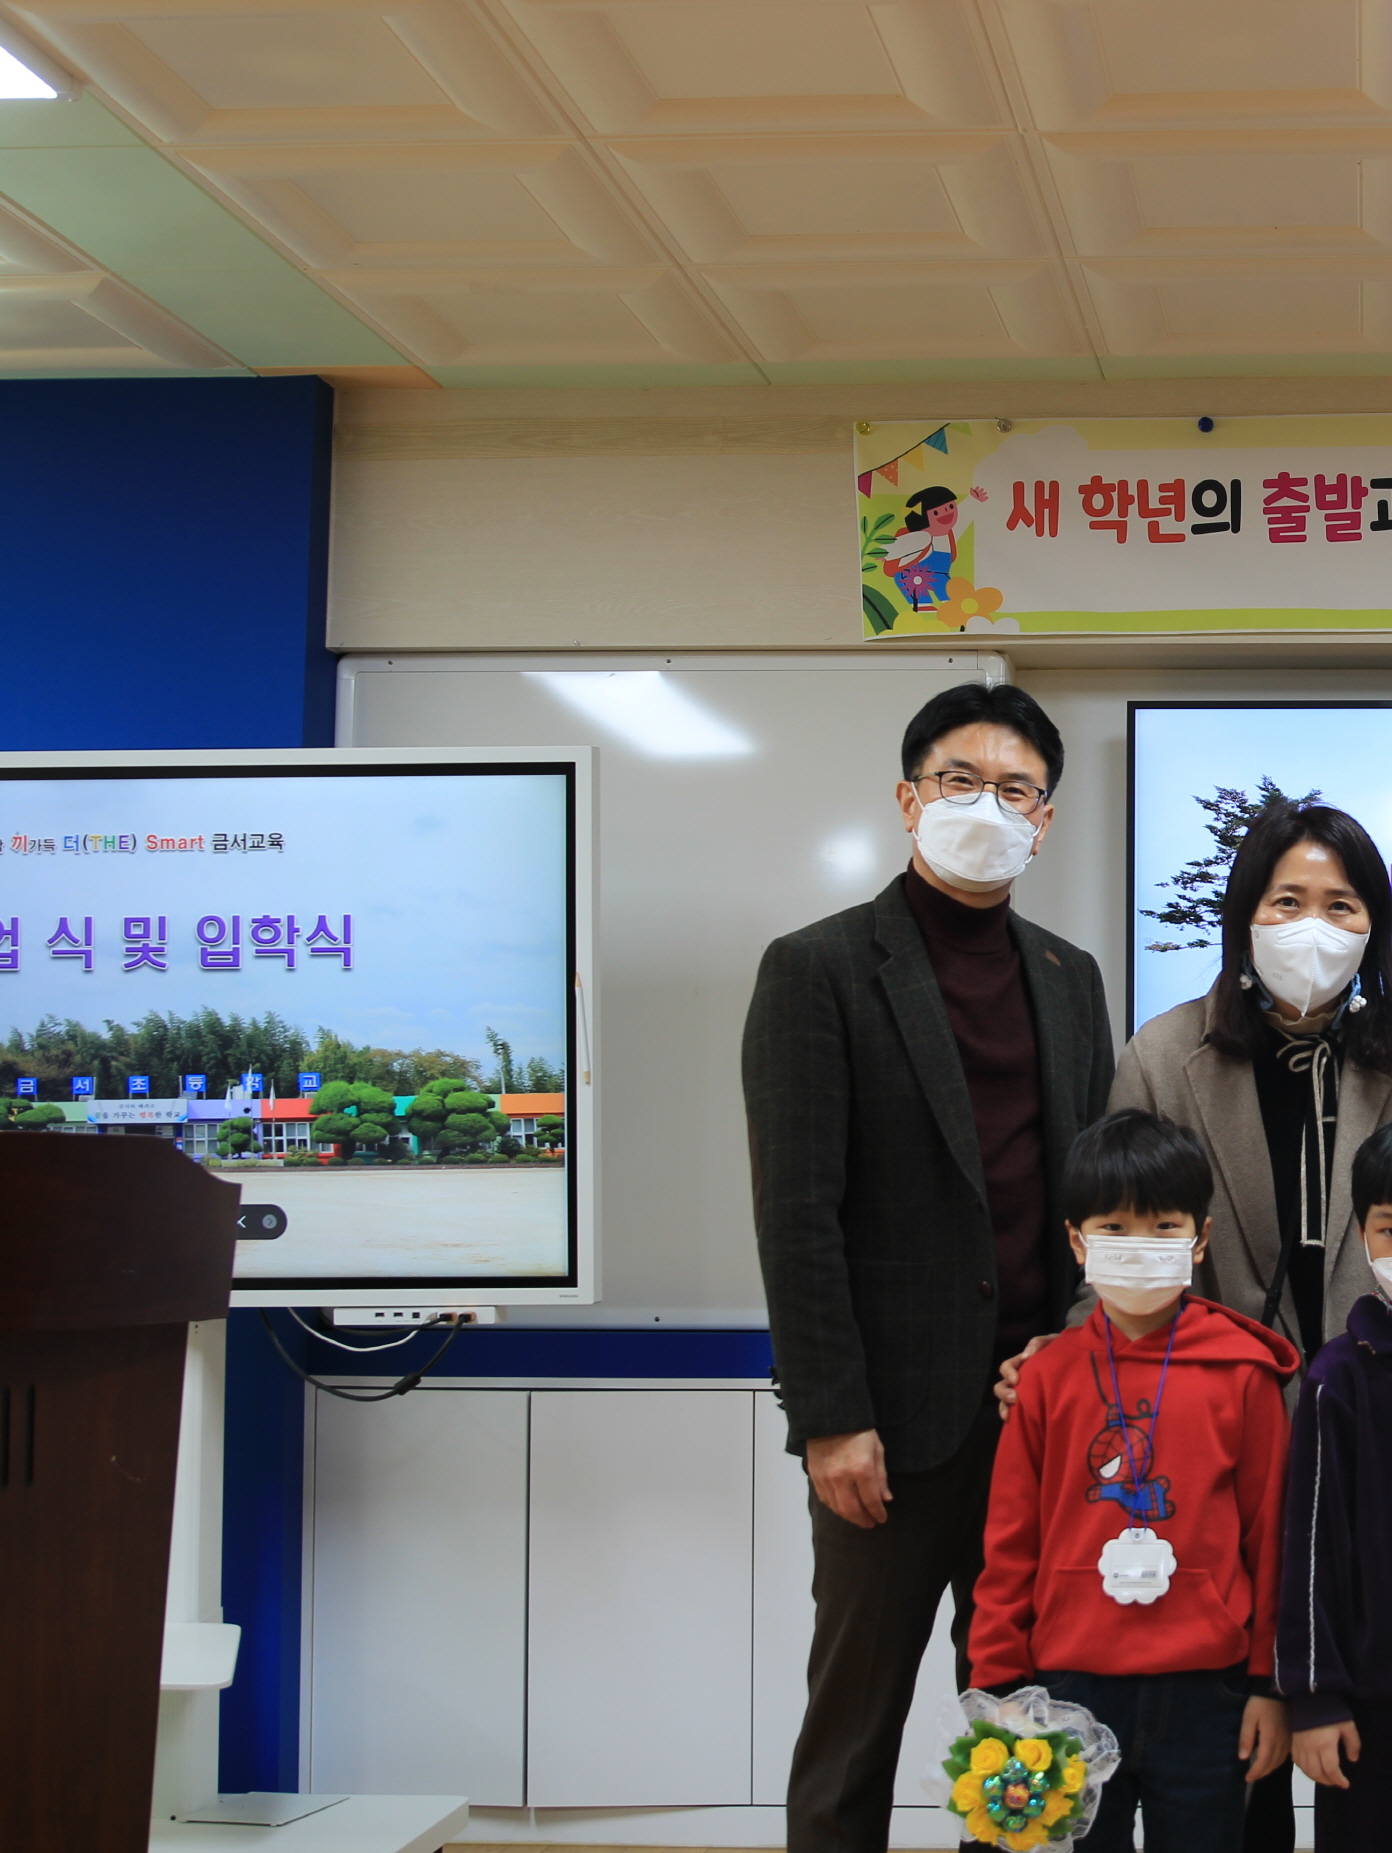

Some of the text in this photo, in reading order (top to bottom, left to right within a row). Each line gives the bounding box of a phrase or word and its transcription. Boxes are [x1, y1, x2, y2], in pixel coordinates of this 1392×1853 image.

[1006, 480, 1060, 538] 새
[1077, 475, 1242, 544] 학년의
[11, 832, 56, 852] 끼가득
[63, 834, 137, 852] 더(THE)
[145, 833, 205, 851] Smart
[211, 832, 286, 851] 금서교육
[47, 916, 94, 970] 식
[123, 915, 168, 971] 및
[196, 914, 354, 970] 입학식
